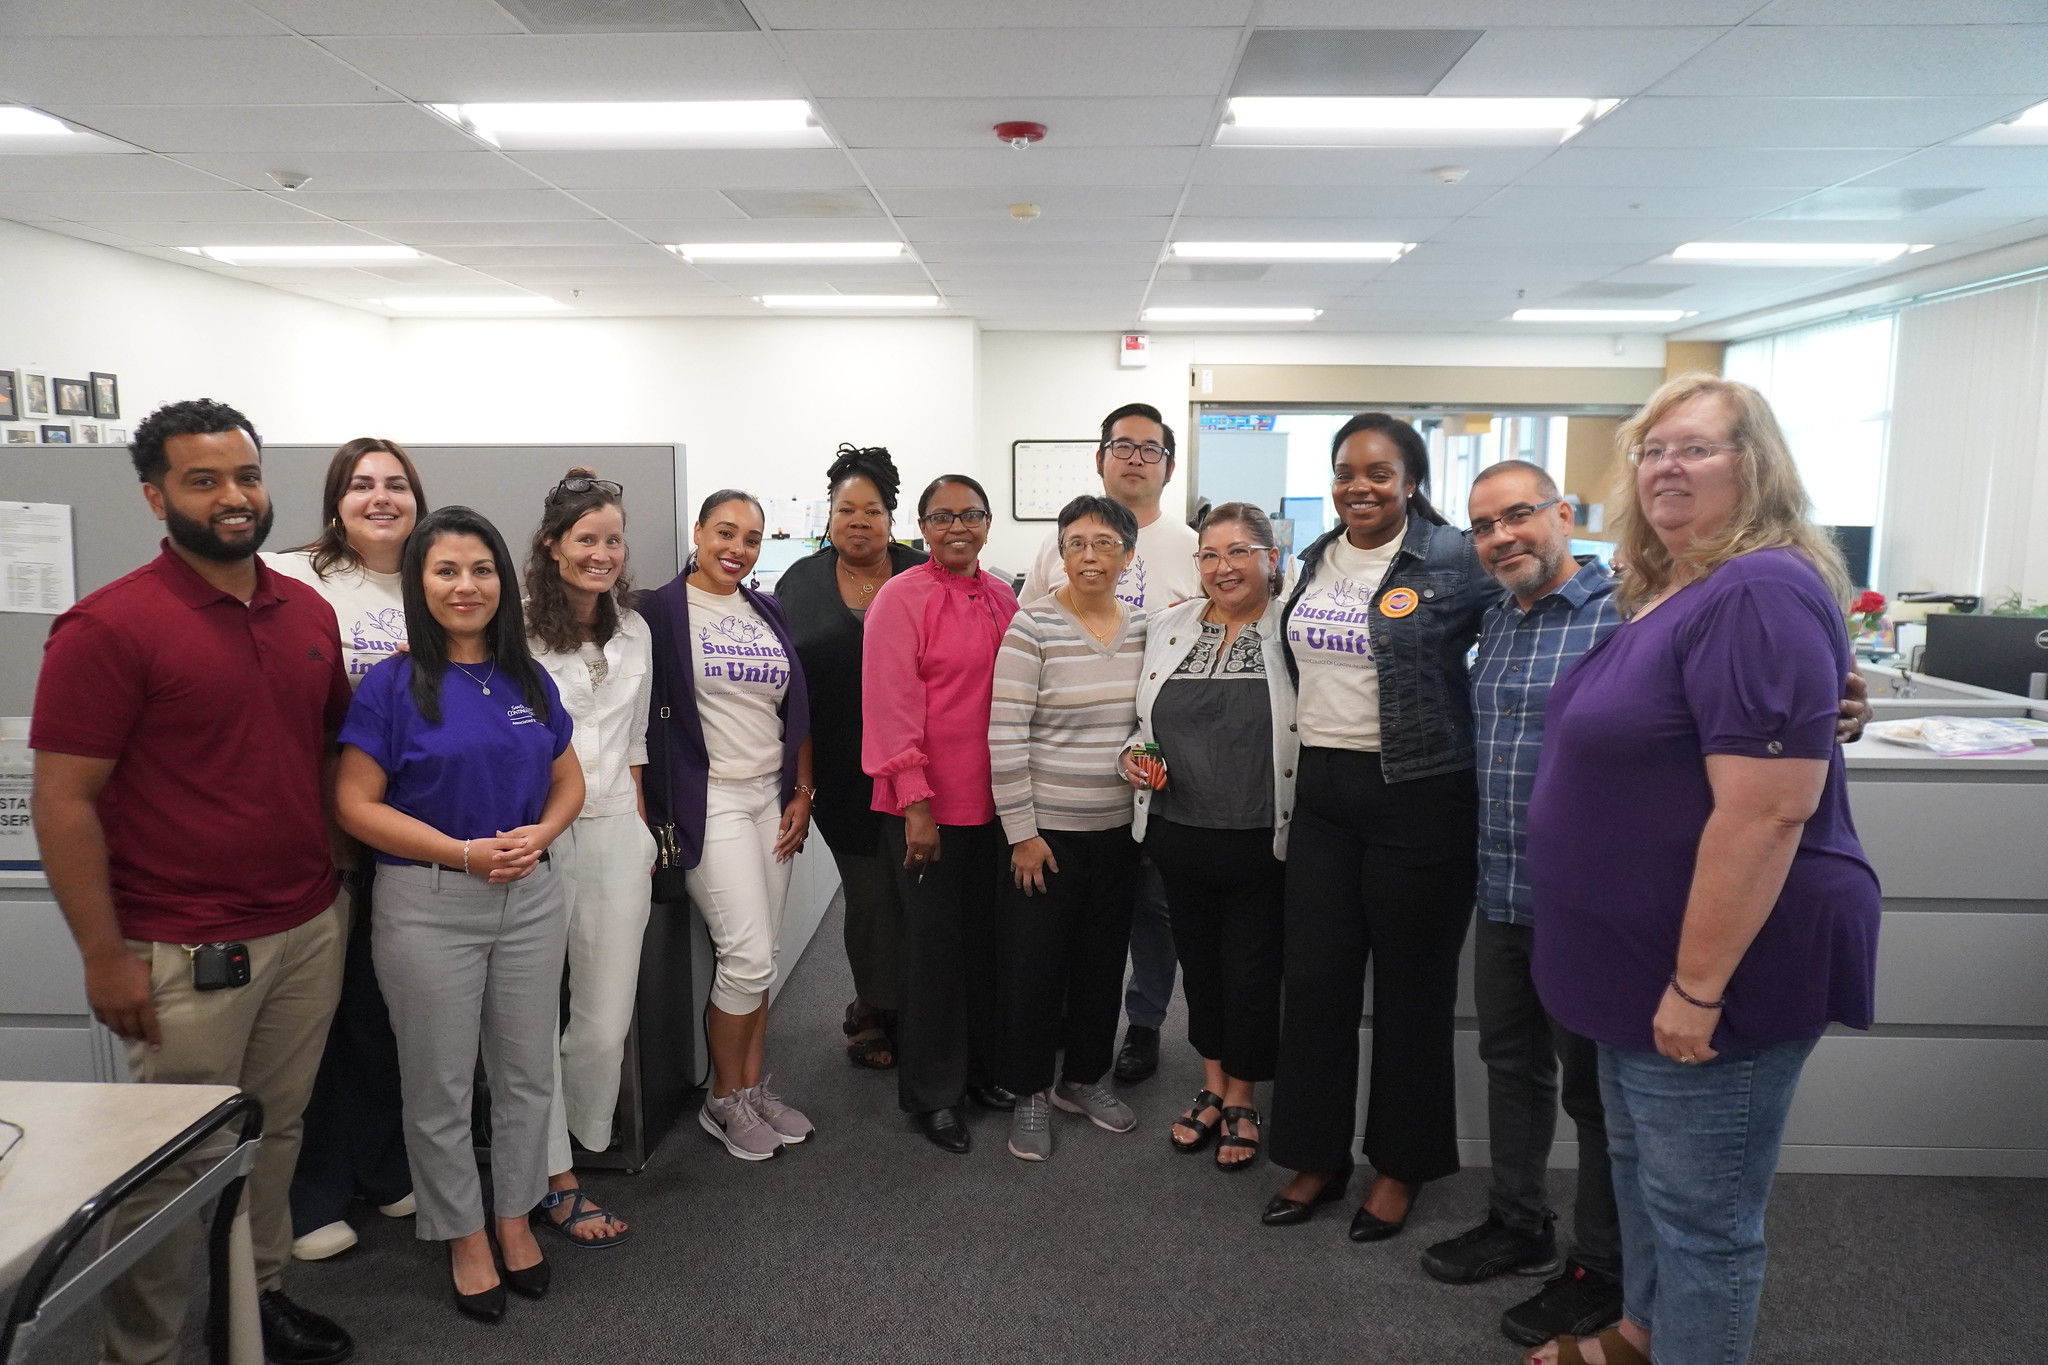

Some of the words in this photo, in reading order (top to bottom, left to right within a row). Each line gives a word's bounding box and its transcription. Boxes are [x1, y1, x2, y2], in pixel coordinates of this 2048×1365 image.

[1289, 625, 1301, 642] in
[704, 662, 722, 677] in
[726, 662, 790, 690] Unity
